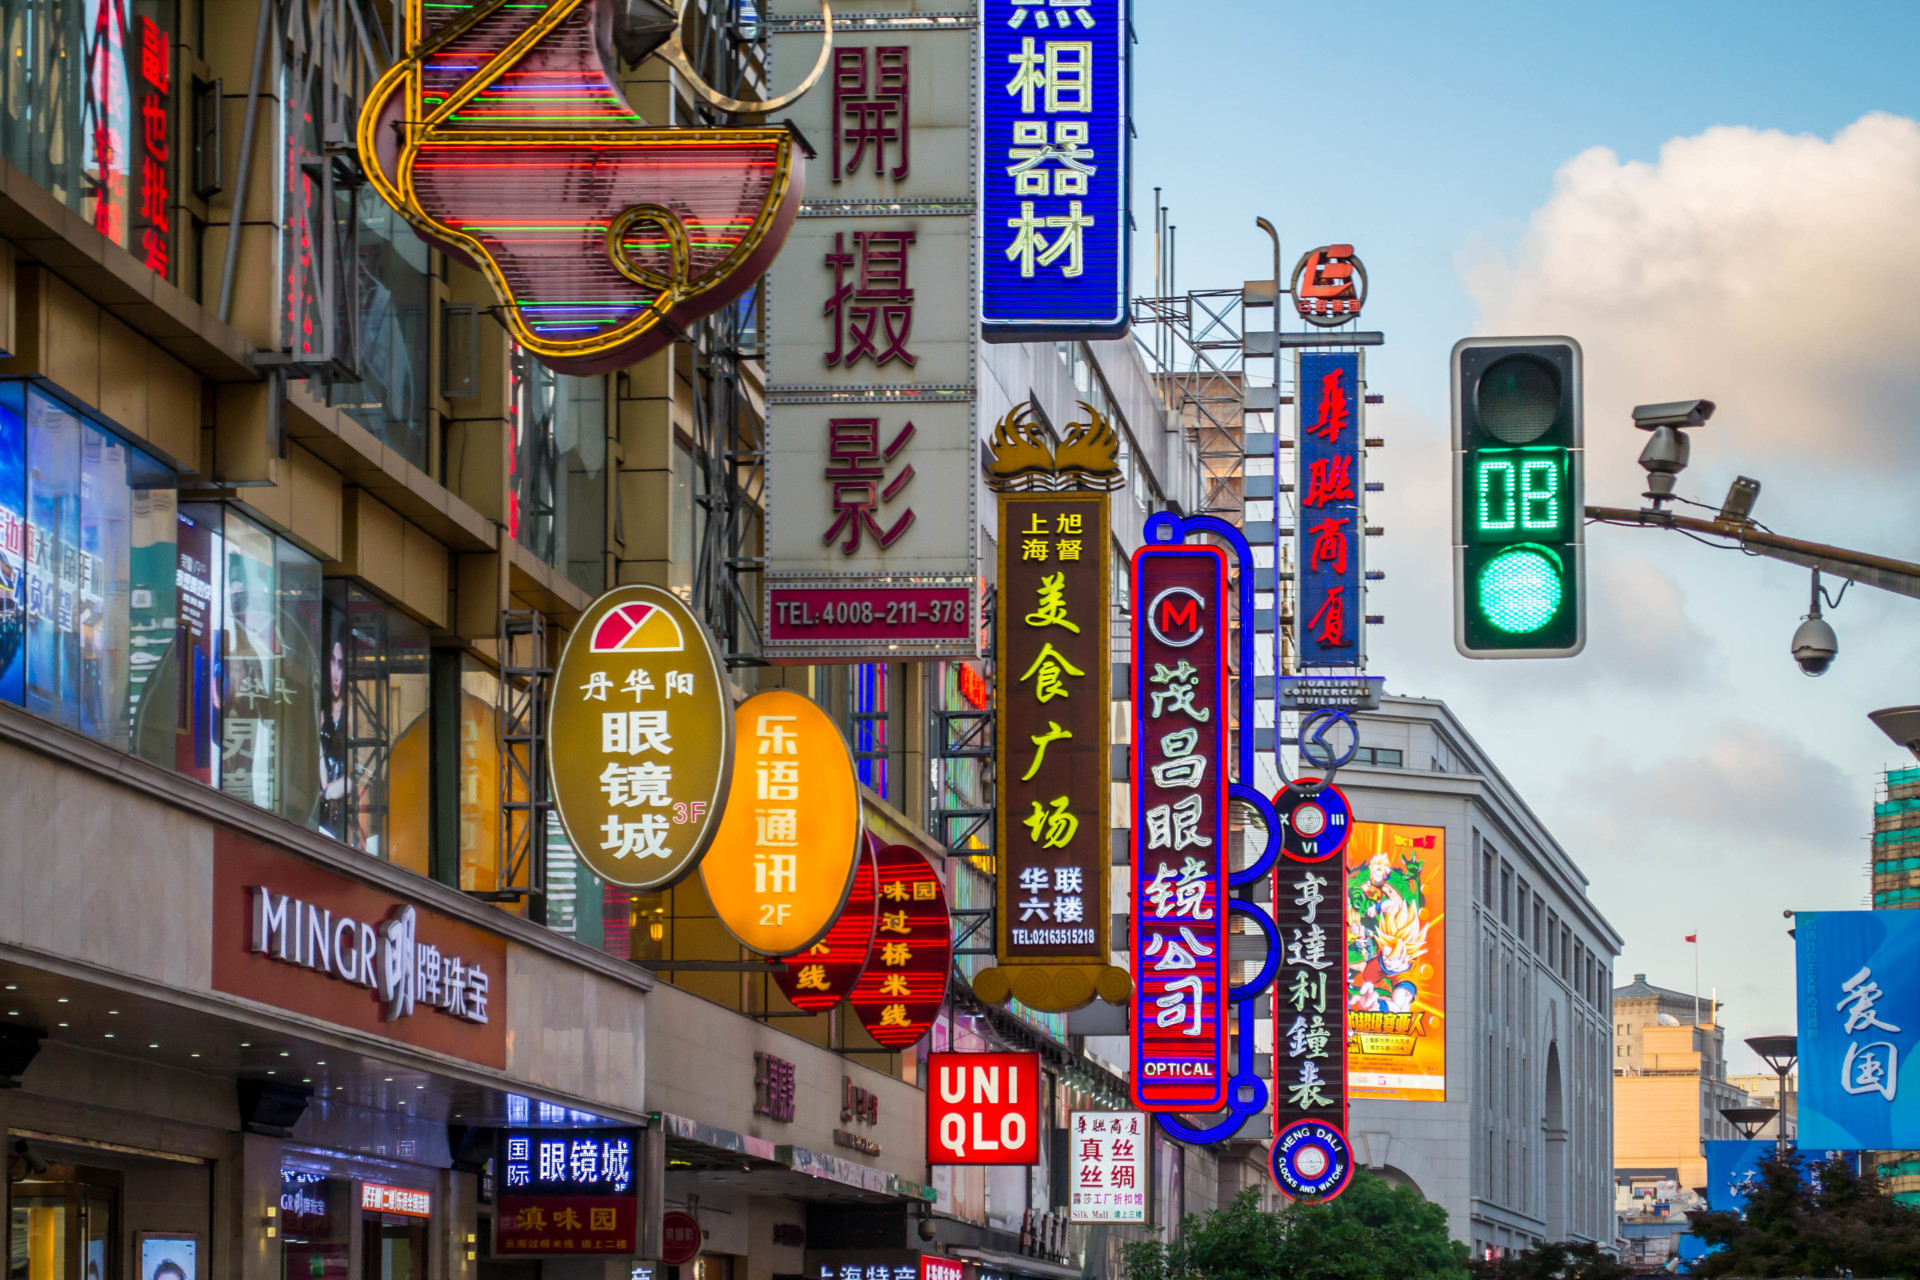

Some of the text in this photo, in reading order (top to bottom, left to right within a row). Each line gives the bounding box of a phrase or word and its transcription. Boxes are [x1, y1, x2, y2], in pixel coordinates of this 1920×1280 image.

[1480, 461, 1557, 530] 08
[580, 668, 694, 704] 丹华阳
[1284, 687, 1371, 697] COMMERCIAL
[1297, 679, 1359, 688] HUALIAN
[1020, 571, 1085, 849] 美食广场
[1297, 697, 1358, 706] BUILDING
[599, 710, 674, 860] 眼镜城
[672, 801, 707, 825] 3F
[754, 715, 799, 893] 乐语通讯
[1145, 660, 1214, 1036] 茂昌眼镜公司
[1301, 841, 1318, 854] VI
[878, 881, 936, 902] 味园
[1019, 867, 1083, 894] 华联
[759, 904, 792, 926] 2F
[1019, 897, 1083, 923] 六楼
[258, 886, 378, 988] MINGR
[1012, 929, 1095, 945] TEL:02163515218
[880, 911, 912, 1027] 过桥米线
[1836, 966, 1902, 1102] 爱国
[1144, 1062, 1213, 1077] OPTICAL
[940, 1066, 1018, 1104] UNI
[940, 1112, 1026, 1157] QLO
[1280, 1128, 1342, 1152] HENG DALI
[507, 1139, 530, 1186] 国际
[539, 1140, 629, 1183] 眼镜城
[1279, 1157, 1298, 1188] CLOCKS
[1299, 1185, 1316, 1194] AND
[516, 1205, 617, 1232] 滇味园
[1072, 1211, 1089, 1219] Silk
[1092, 1211, 1109, 1219] Mall
